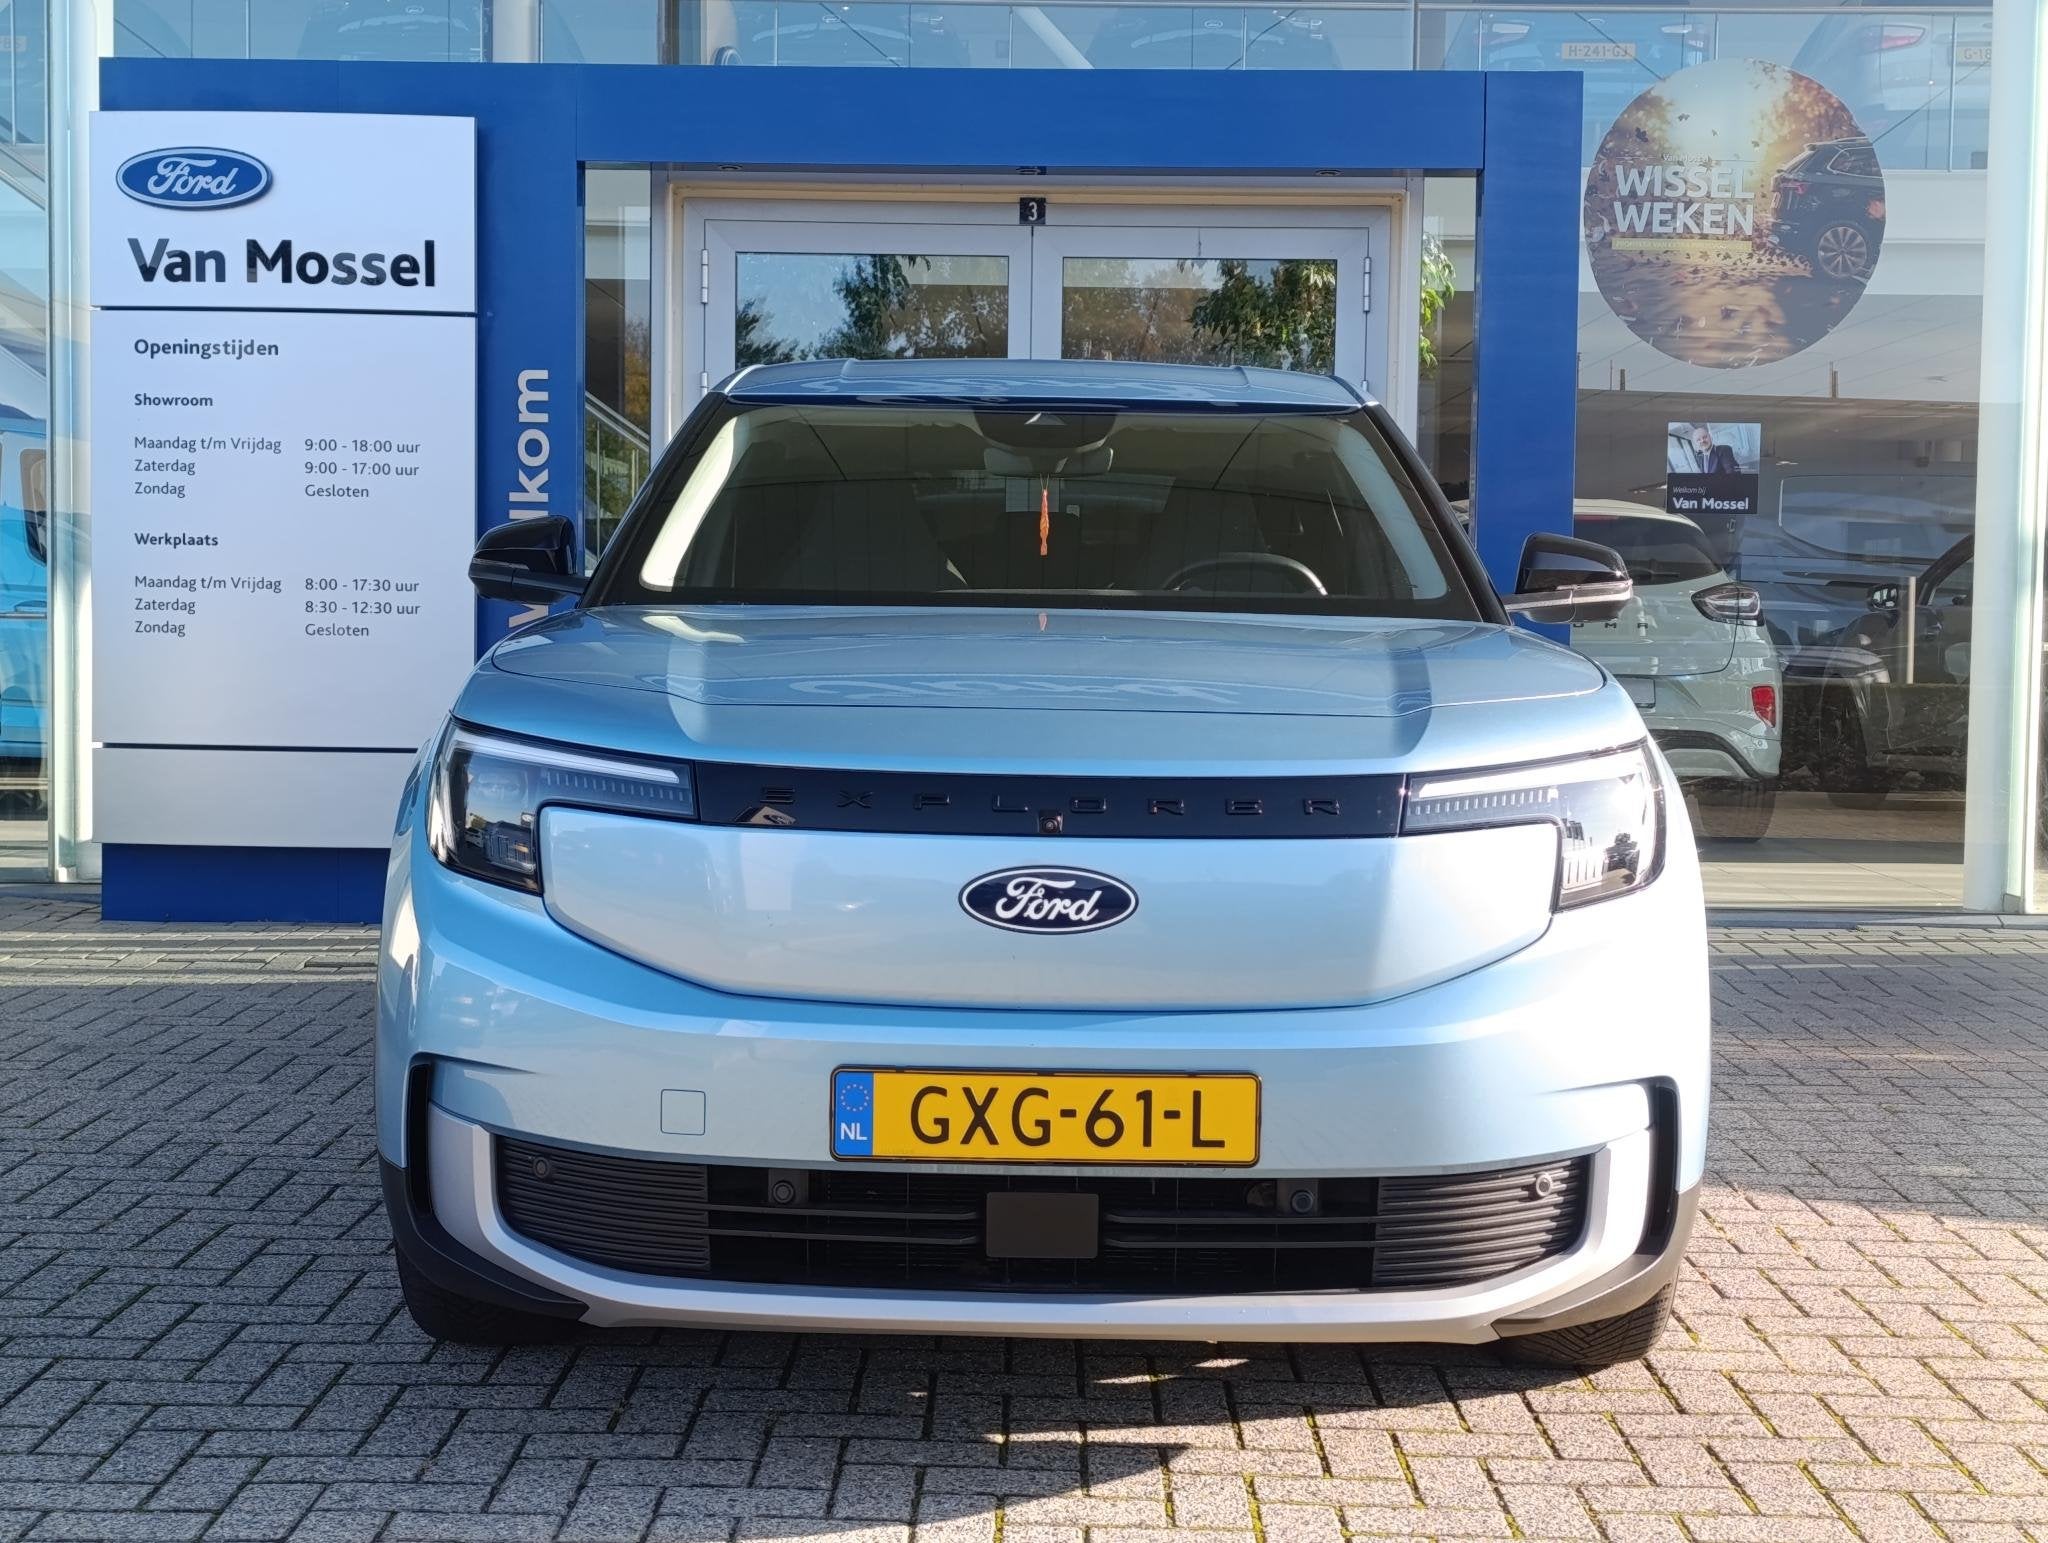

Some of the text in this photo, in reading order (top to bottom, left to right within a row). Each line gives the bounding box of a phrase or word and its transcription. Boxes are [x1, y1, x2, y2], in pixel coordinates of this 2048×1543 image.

[147, 156, 239, 195] Ford
[1615, 164, 1755, 199] WISSEL
[1028, 201, 1038, 221] 3
[1613, 201, 1754, 236] WEKEN
[127, 237, 436, 288] Van Mossel
[133, 338, 280, 361] Openingstijden
[133, 392, 214, 408] Showroom
[134, 436, 197, 454] Maandag
[200, 436, 227, 451] t/m
[230, 437, 282, 455] Vrijdag
[304, 438, 338, 453] 9:00
[351, 439, 393, 454] 18:00
[396, 443, 421, 454] uur
[134, 459, 196, 477] Zaterdag
[304, 461, 338, 476] 9:00
[351, 462, 391, 476] 17:00
[395, 466, 420, 477] uur
[134, 481, 370, 499] Zondag Gesloten
[1672, 496, 1750, 511] Van Mossel
[134, 531, 219, 549] Werkplaats
[134, 575, 197, 593] Maandag
[200, 575, 227, 590] t/m
[230, 576, 282, 594] Vrijdag
[304, 577, 338, 591] 8:00
[351, 578, 391, 592] 17:30
[395, 582, 420, 593] uur
[134, 598, 197, 616] Zaterdag
[304, 600, 338, 614] 8:30
[351, 601, 393, 615] 12:30
[396, 605, 421, 615] uur
[134, 620, 370, 638] Zondag Gesloten
[760, 786, 1342, 816] EXPLORER
[995, 876, 1103, 922] Ford
[910, 1085, 1226, 1149] GXG-61-L
[840, 1122, 868, 1142] NL
